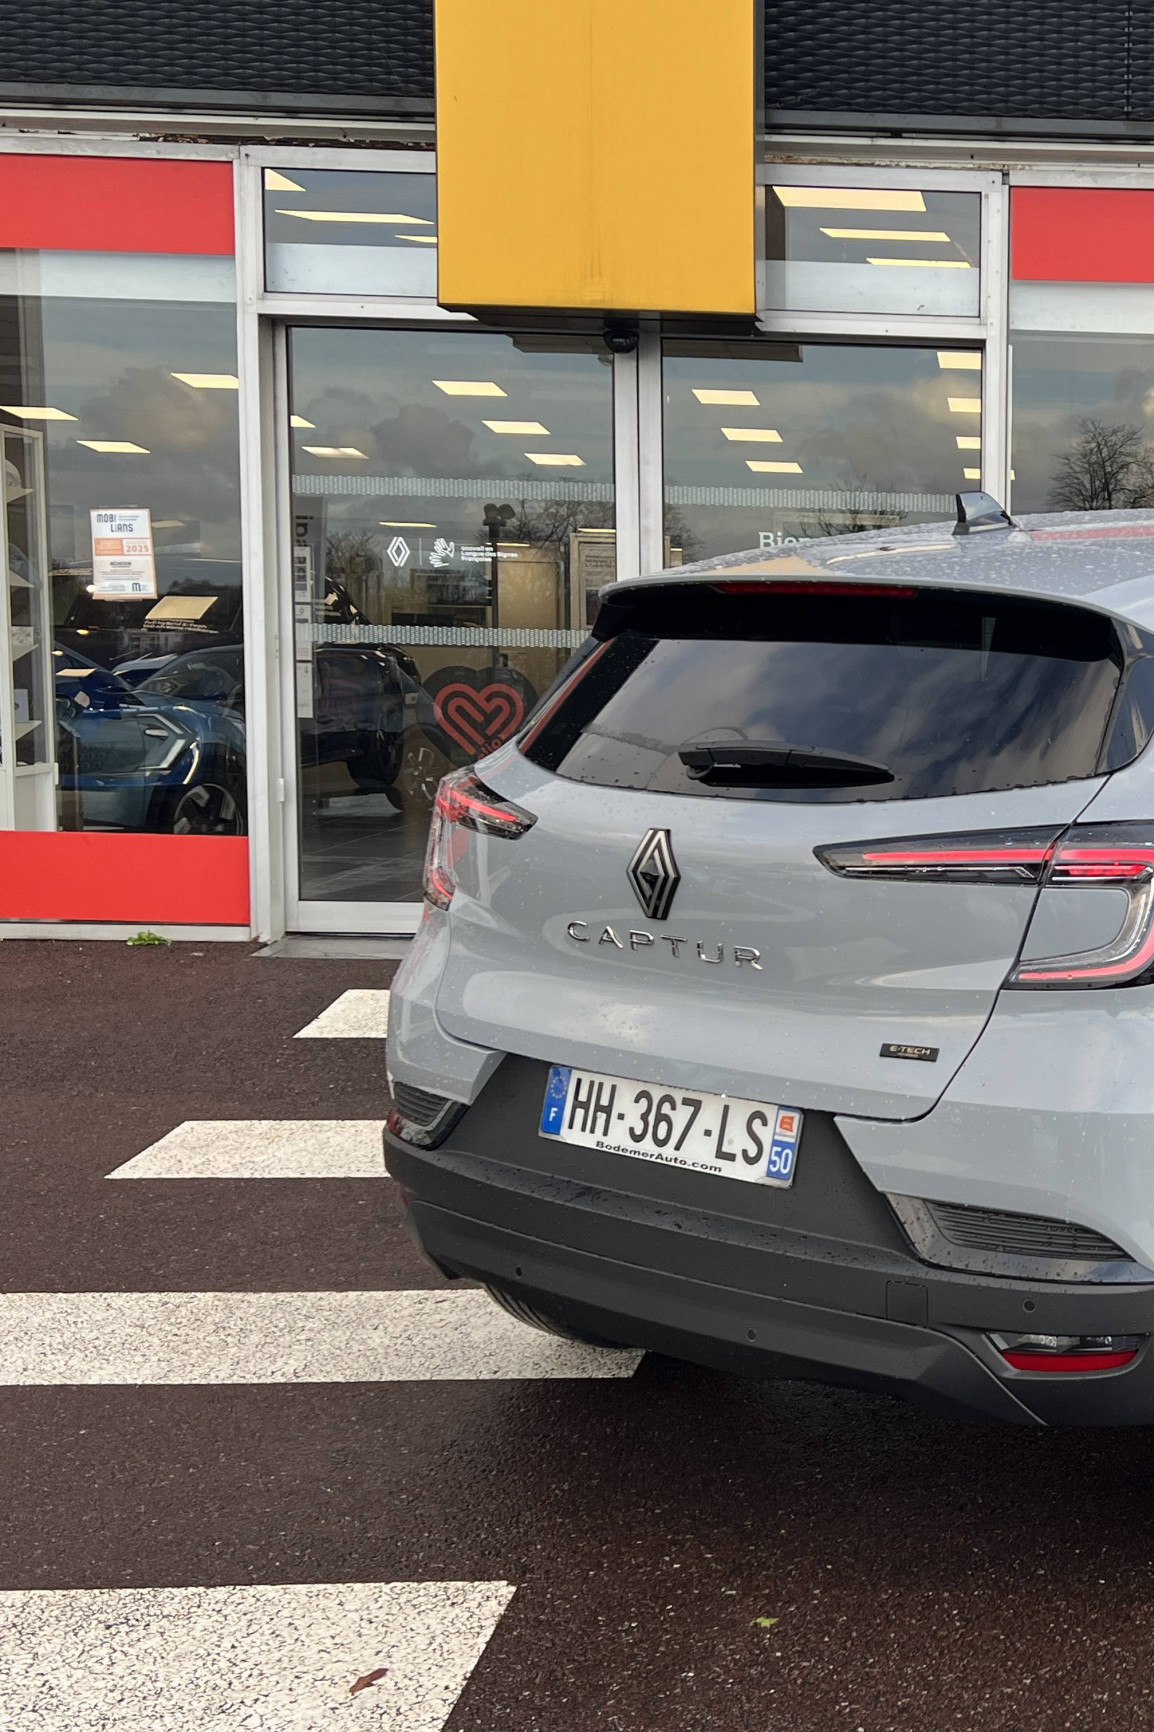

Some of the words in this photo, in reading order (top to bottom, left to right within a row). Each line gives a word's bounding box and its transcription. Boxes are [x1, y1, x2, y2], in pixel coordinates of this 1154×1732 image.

[126, 545, 149, 553] 2025
[567, 920, 764, 971] CAPTUR
[548, 1107, 558, 1122] F
[567, 1077, 768, 1166] HH-367-LS
[595, 1140, 722, 1173] BodemerAuto.com
[769, 1146, 793, 1175] 50
